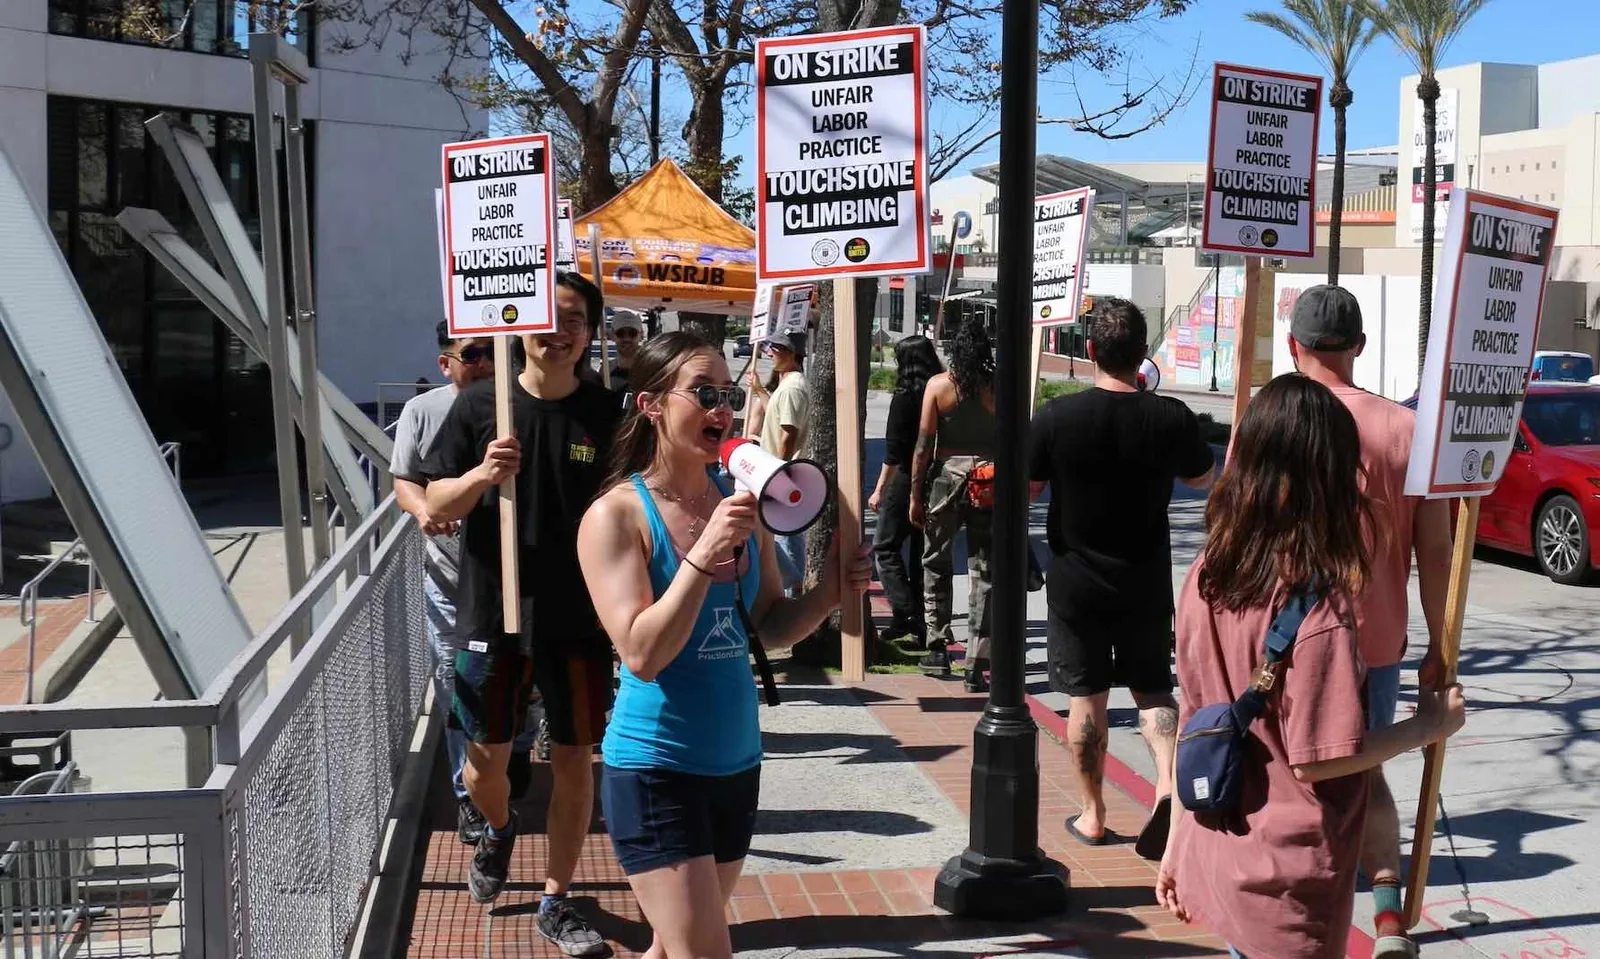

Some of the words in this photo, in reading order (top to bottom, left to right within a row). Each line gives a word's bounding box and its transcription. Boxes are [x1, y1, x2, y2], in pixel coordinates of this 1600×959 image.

[774, 53, 808, 80] ON
[814, 43, 899, 77] STRIKE
[811, 85, 873, 107] UNFAIR
[1224, 78, 1246, 99] ON
[1251, 80, 1307, 107] STRIKE
[812, 111, 868, 133] LABOR
[1247, 110, 1288, 129] UNFAIR
[799, 136, 882, 160] PRACTICE
[1246, 130, 1283, 148] LABOR
[453, 151, 476, 178] ON
[478, 149, 535, 174] STRIKE
[1236, 149, 1291, 169] PRACTICE
[767, 161, 914, 196] TOUCHSTONE
[1214, 168, 1309, 197] TOUCHSTONE
[478, 182, 517, 200] UNFAIR
[479, 203, 514, 220] LABOR
[785, 196, 896, 230] CLIMBING
[1042, 200, 1078, 219] STRIKE
[1224, 196, 1297, 221] CLIMBING
[472, 223, 524, 242] PRACTICE
[1038, 222, 1065, 236] UNFAIR
[1473, 214, 1495, 250] ON
[1495, 219, 1544, 257] STRIKE
[1036, 236, 1061, 249] LABOR
[453, 244, 546, 271] TOUCHSTONE
[1033, 249, 1065, 263] RACTICE
[464, 272, 535, 297] CLIMBING
[646, 264, 725, 286] WSRJB
[1033, 264, 1075, 282] CHSTONE
[1488, 266, 1523, 292] UNFAIR
[1033, 283, 1066, 299] MBING
[1484, 298, 1516, 323] LABOR
[1472, 329, 1520, 354] PRACTICE
[1449, 364, 1527, 395] TOUCHSTONE
[1453, 405, 1514, 435] CLIMBING
